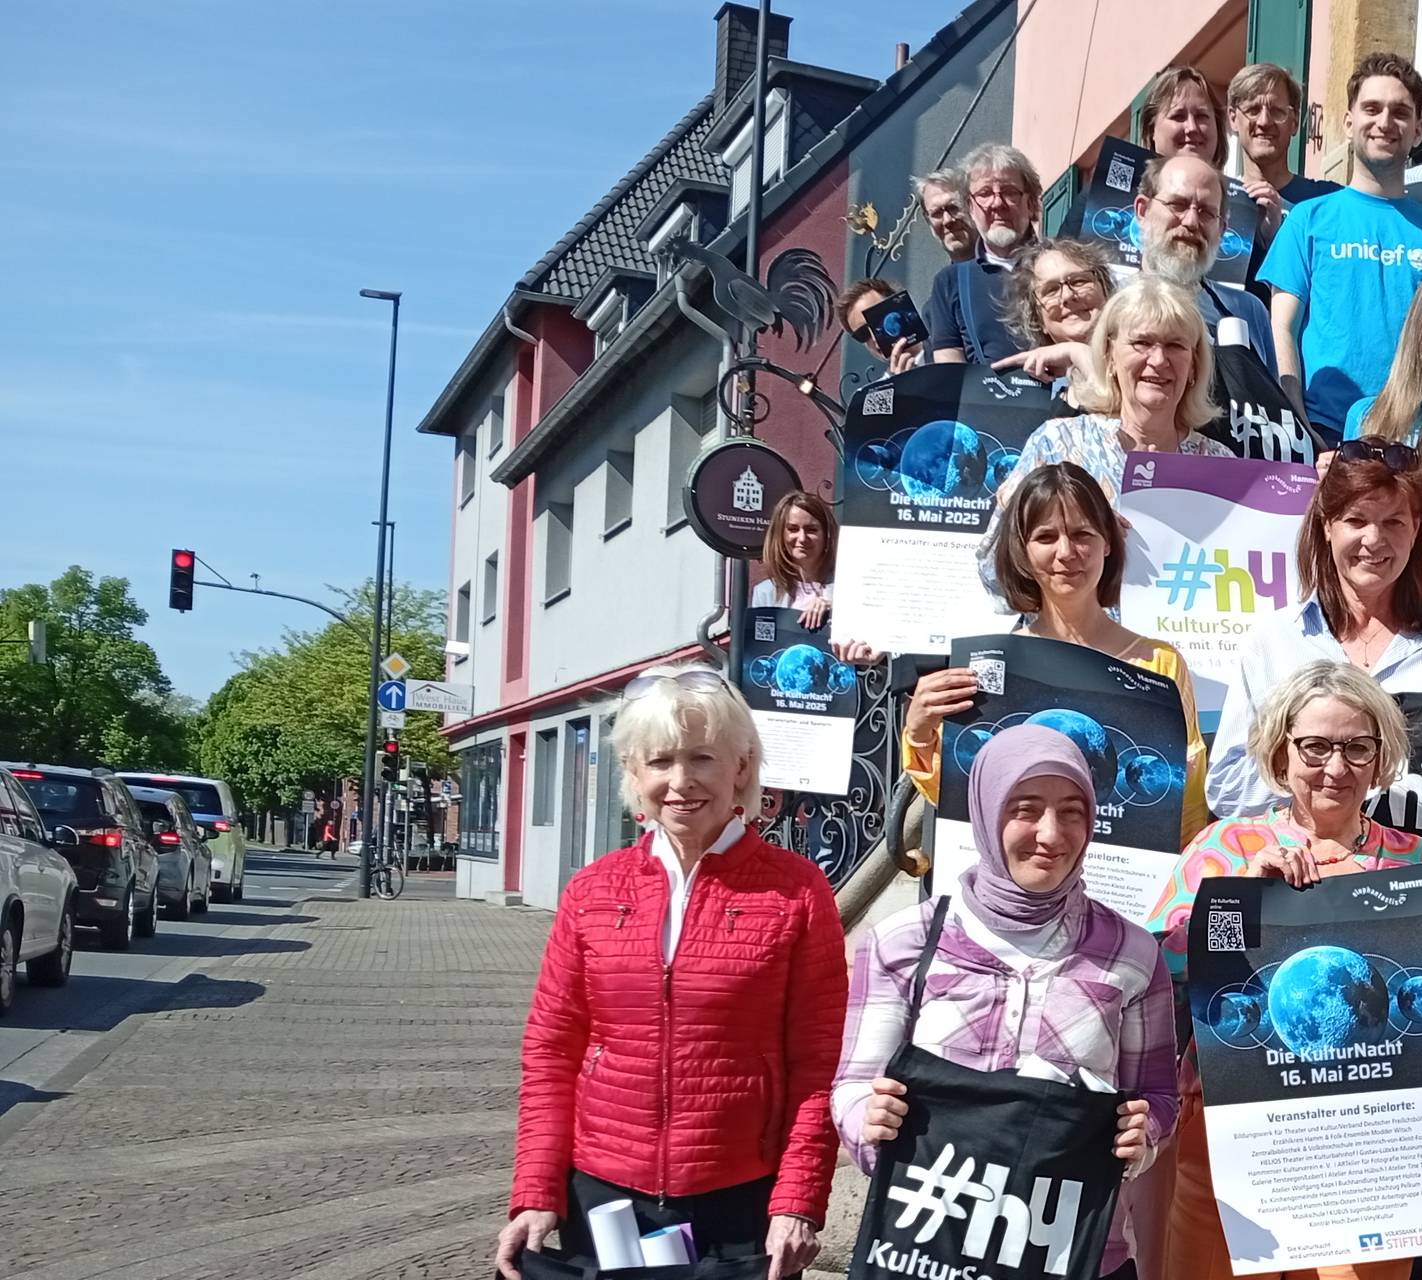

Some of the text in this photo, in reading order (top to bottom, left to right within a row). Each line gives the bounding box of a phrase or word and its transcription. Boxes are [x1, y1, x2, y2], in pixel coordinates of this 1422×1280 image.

[1119, 241, 1138, 253] Die
[1330, 239, 1405, 267] unicef
[890, 492, 992, 510] Die KulturNacht
[897, 509, 980, 525] 16. Mai 2025
[881, 536, 930, 547] Veranstalter
[932, 540, 948, 548] und
[789, 700, 804, 709] Mai
[805, 702, 827, 712] 2025
[1087, 851, 1130, 864] pielorte:
[1266, 1040, 1403, 1066] Die KulturNacht
[1280, 1062, 1393, 1087] 16. Mai 2025
[1267, 1101, 1415, 1123] Veranstalter und Spielorte:
[866, 1239, 993, 1280] KulturS
